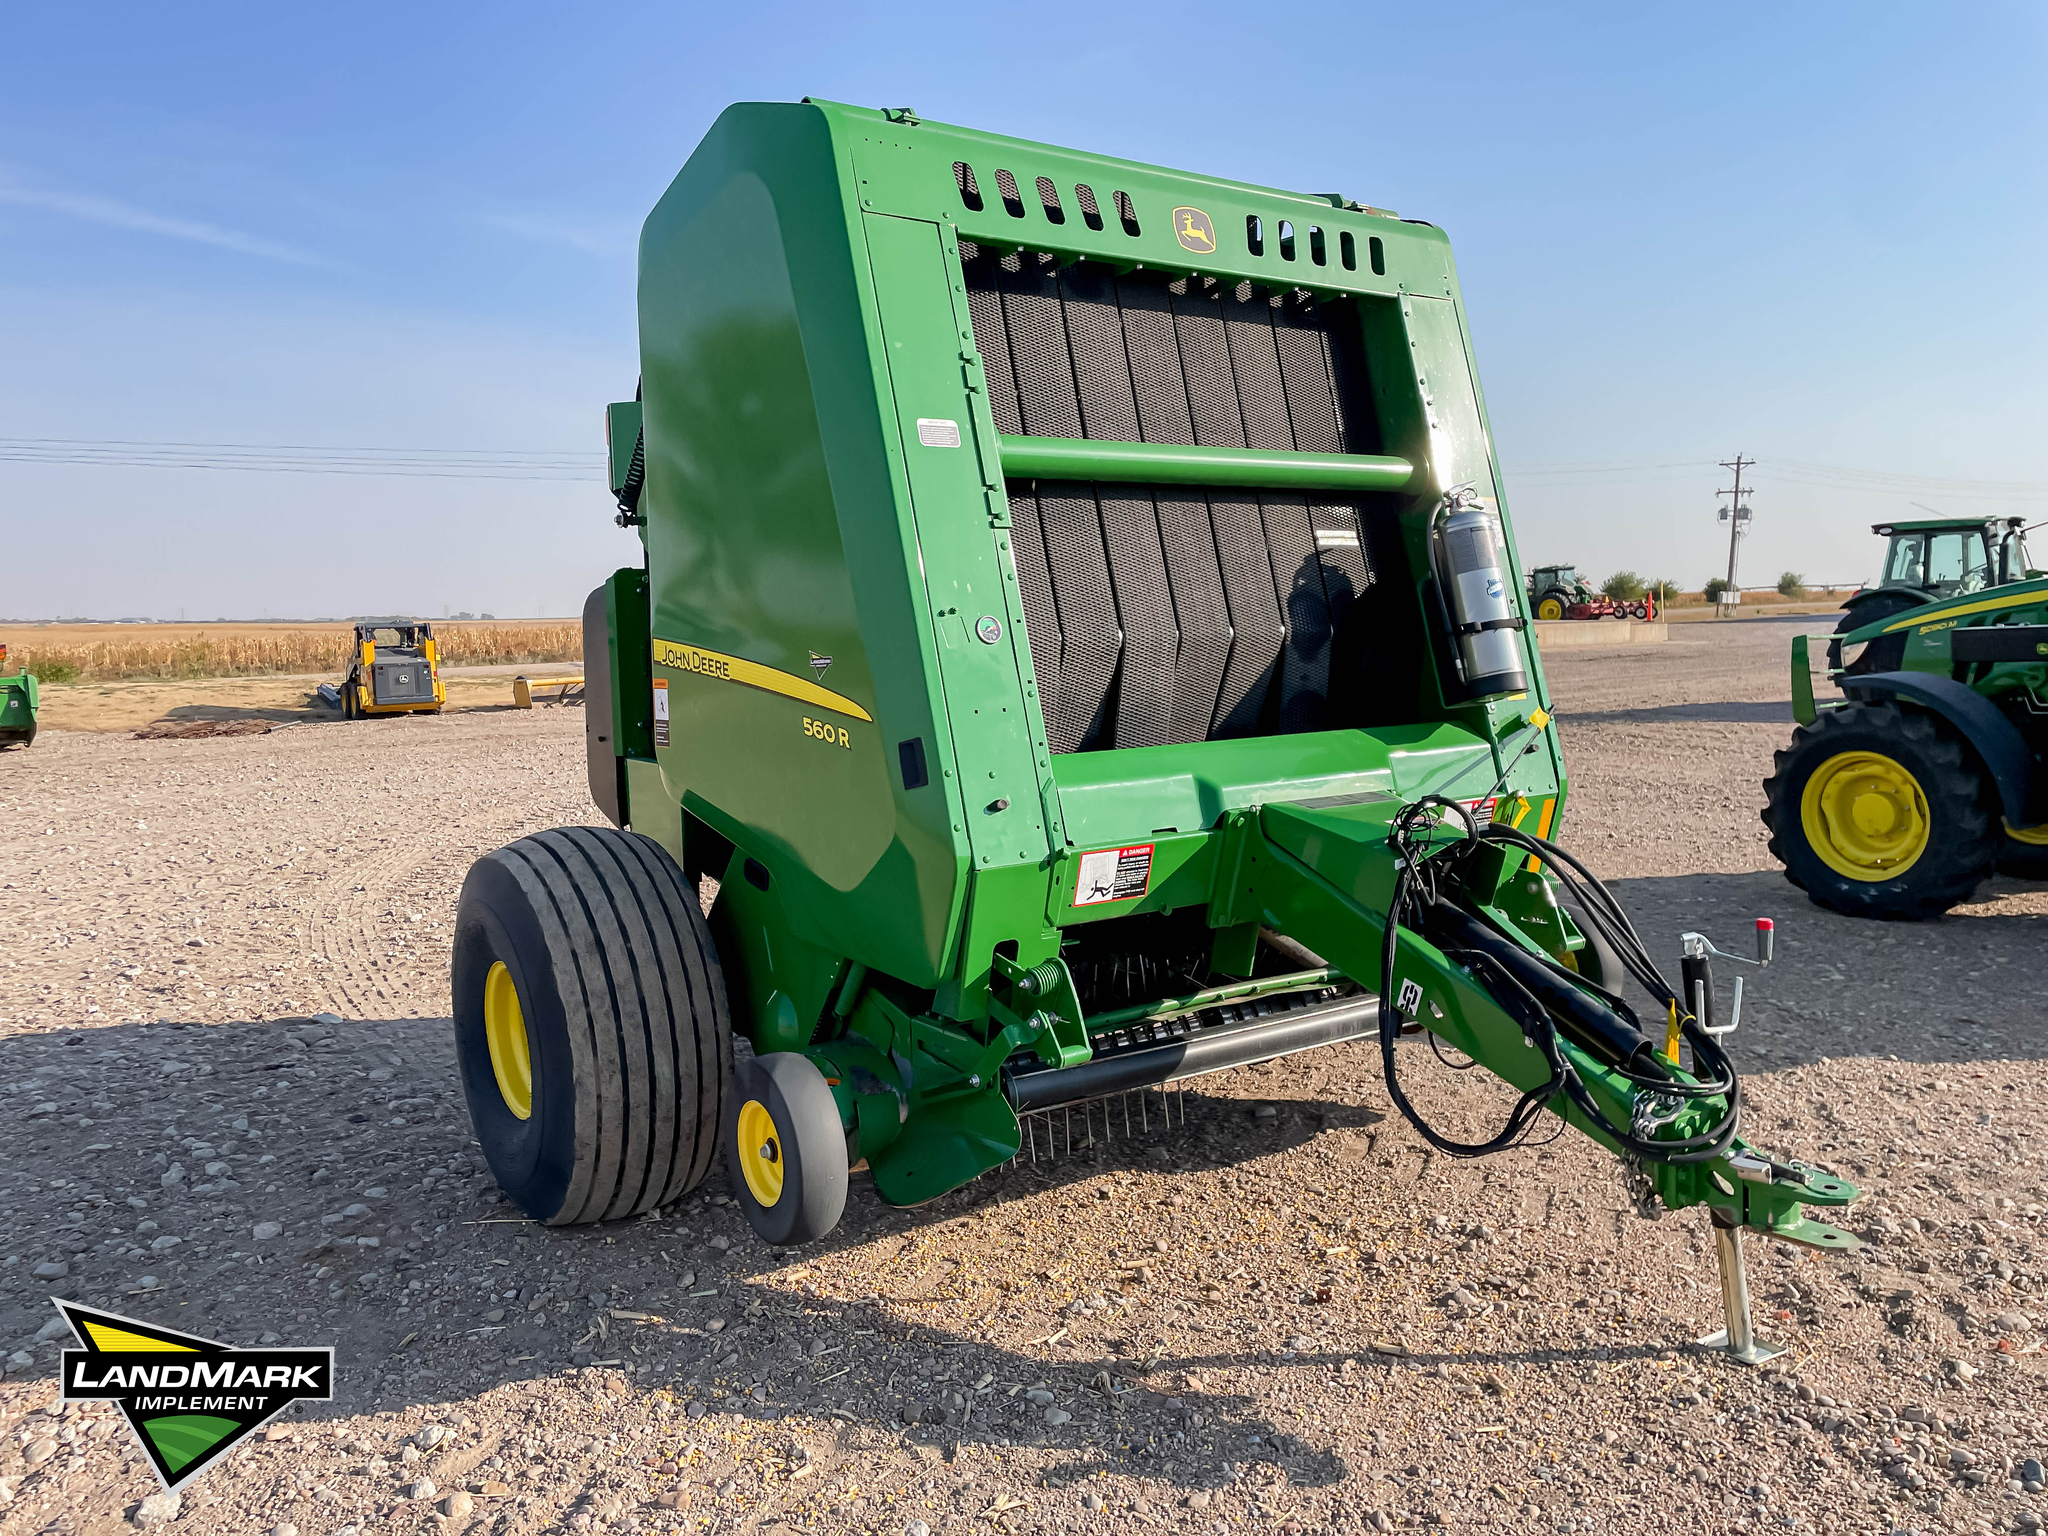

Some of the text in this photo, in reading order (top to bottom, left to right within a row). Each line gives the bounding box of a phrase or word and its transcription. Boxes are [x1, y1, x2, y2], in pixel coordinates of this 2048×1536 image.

[662, 645, 730, 678] JOHN DEERE
[803, 716, 852, 749] 560 R
[1128, 847, 1150, 855] DANGER
